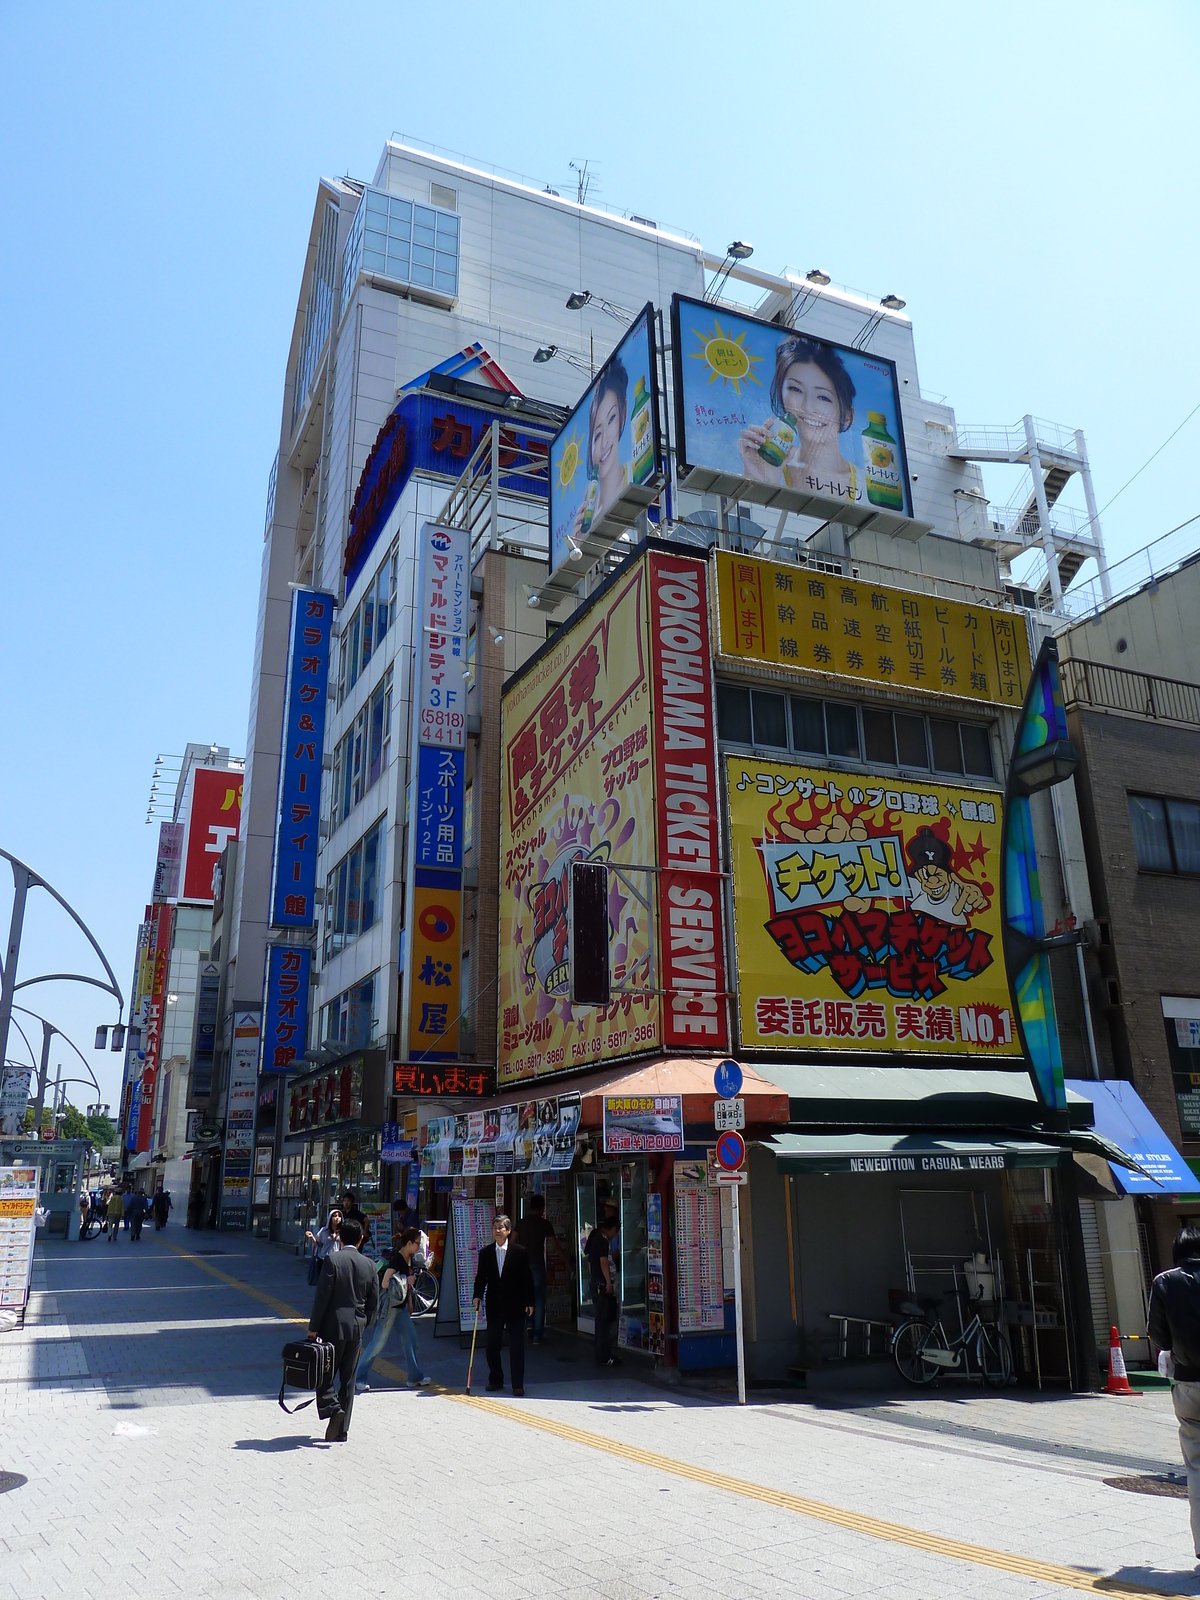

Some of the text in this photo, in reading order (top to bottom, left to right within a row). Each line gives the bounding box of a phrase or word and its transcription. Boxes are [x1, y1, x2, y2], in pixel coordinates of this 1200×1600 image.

[715, 358, 743, 367] レモン!
[716, 348, 734, 357] 朝は
[694, 404, 715, 417] 朝の
[696, 414, 747, 427] キレイと元気!
[805, 475, 863, 501] キレートレモン
[428, 554, 449, 686] マイルドシティ
[737, 563, 760, 650] 買います
[775, 571, 799, 658] 新幹線
[808, 579, 832, 664] 商品券
[840, 586, 864, 670] 高速券
[870, 592, 895, 675] 航空券
[657, 569, 706, 750] YOKOHAMA
[901, 599, 927, 680] 印紙切手
[935, 606, 957, 687] ビール券
[964, 612, 989, 693] カード類
[995, 618, 1018, 698] 売ります
[505, 643, 571, 719] yokohamaticket.co.jp
[421, 708, 465, 728] (5818)
[422, 725, 462, 745] 4411
[511, 643, 601, 791] 商品券
[283, 600, 325, 917] カラオケ&パーティー館
[511, 681, 649, 844] Yokohama Ticket Service
[514, 699, 603, 818] &チケット
[601, 723, 649, 776] プロ野球
[603, 757, 650, 798] サッカー
[421, 787, 434, 826] イシイ
[436, 750, 457, 863] スポーツ用品
[664, 762, 711, 873] TICKET
[756, 773, 996, 824] コンサート プロ野球 観劇
[505, 826, 548, 870] スペシャル
[505, 857, 535, 890] イベント
[775, 840, 902, 902] チケット!
[925, 850, 935, 862] Y
[667, 884, 719, 1035] SERVICE
[764, 908, 995, 981] ヨコハマチケット
[830, 944, 948, 1001] サービス
[273, 950, 302, 1068] カラオケ館
[418, 955, 453, 1035] 松屋
[596, 984, 655, 1023] コンサート
[756, 995, 1013, 1045] 委託販売 実績 No.1
[144, 1004, 160, 1072] エスパス
[503, 1017, 553, 1051] ミュージカル
[395, 1064, 490, 1095] 買います
[607, 1098, 678, 1111] 新大阪のぞみ 自由席
[608, 1137, 631, 1150] 片道
[633, 1134, 681, 1150] ¥12000
[850, 1155, 1005, 1172] NEWEDITION CASUAL WEARS
[1145, 1153, 1172, 1161] STYLES
